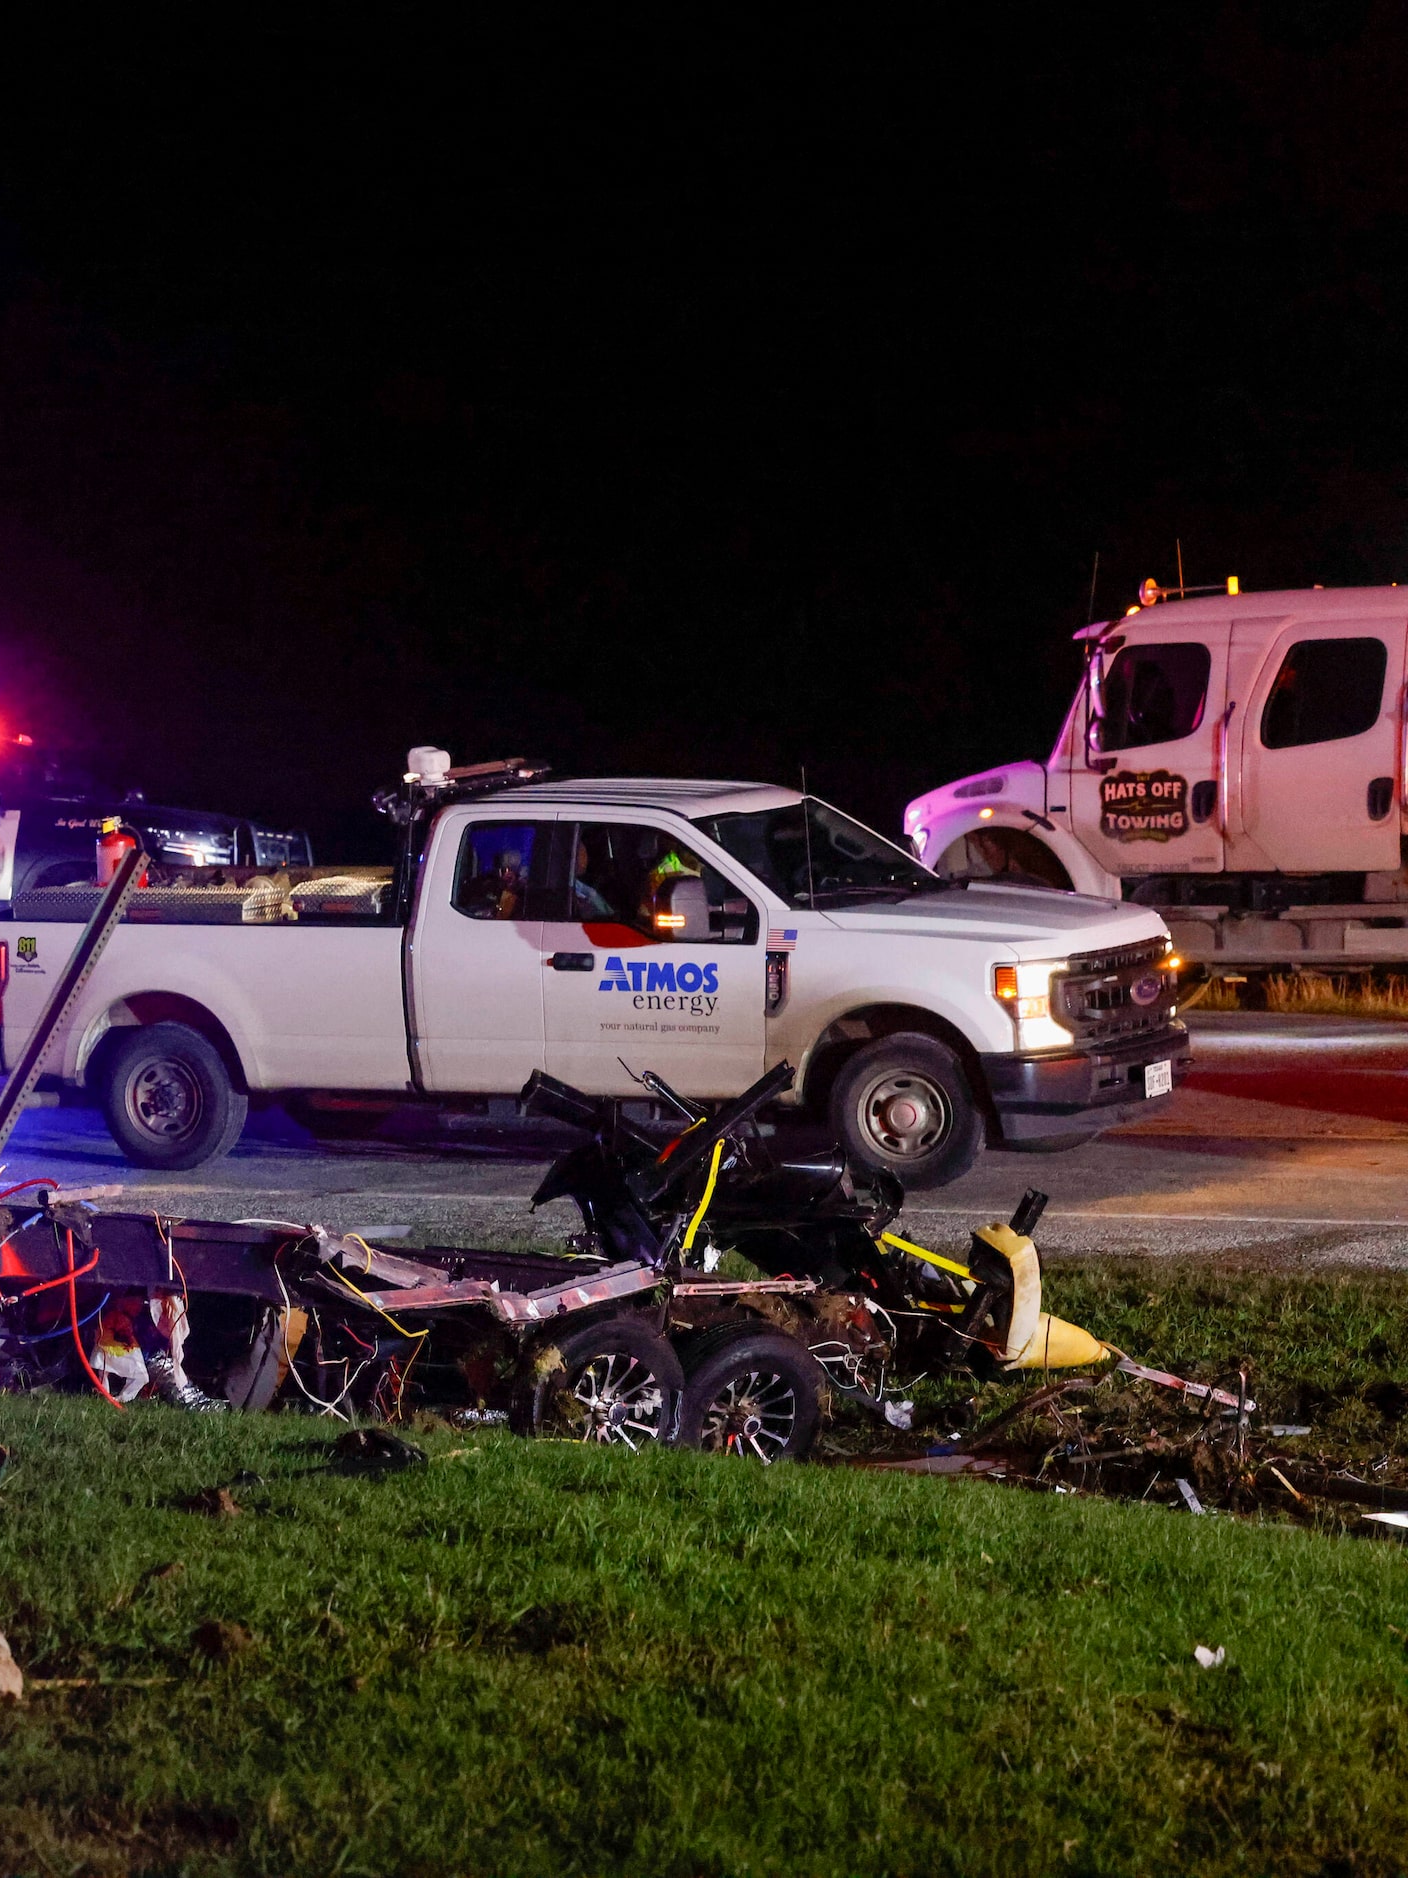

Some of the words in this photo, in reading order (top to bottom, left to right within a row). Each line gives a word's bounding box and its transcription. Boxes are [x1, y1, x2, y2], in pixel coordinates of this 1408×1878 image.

[1104, 782, 1146, 802] HATS
[1151, 782, 1181, 799] OFF
[1106, 811, 1184, 829] TOWING
[18, 937, 36, 953] 811
[598, 956, 719, 994] ATMOS
[633, 994, 719, 1017] energy
[600, 1023, 621, 1031] your
[623, 1021, 658, 1032] natural
[660, 1024, 676, 1034] gas
[678, 1024, 720, 1035] company
